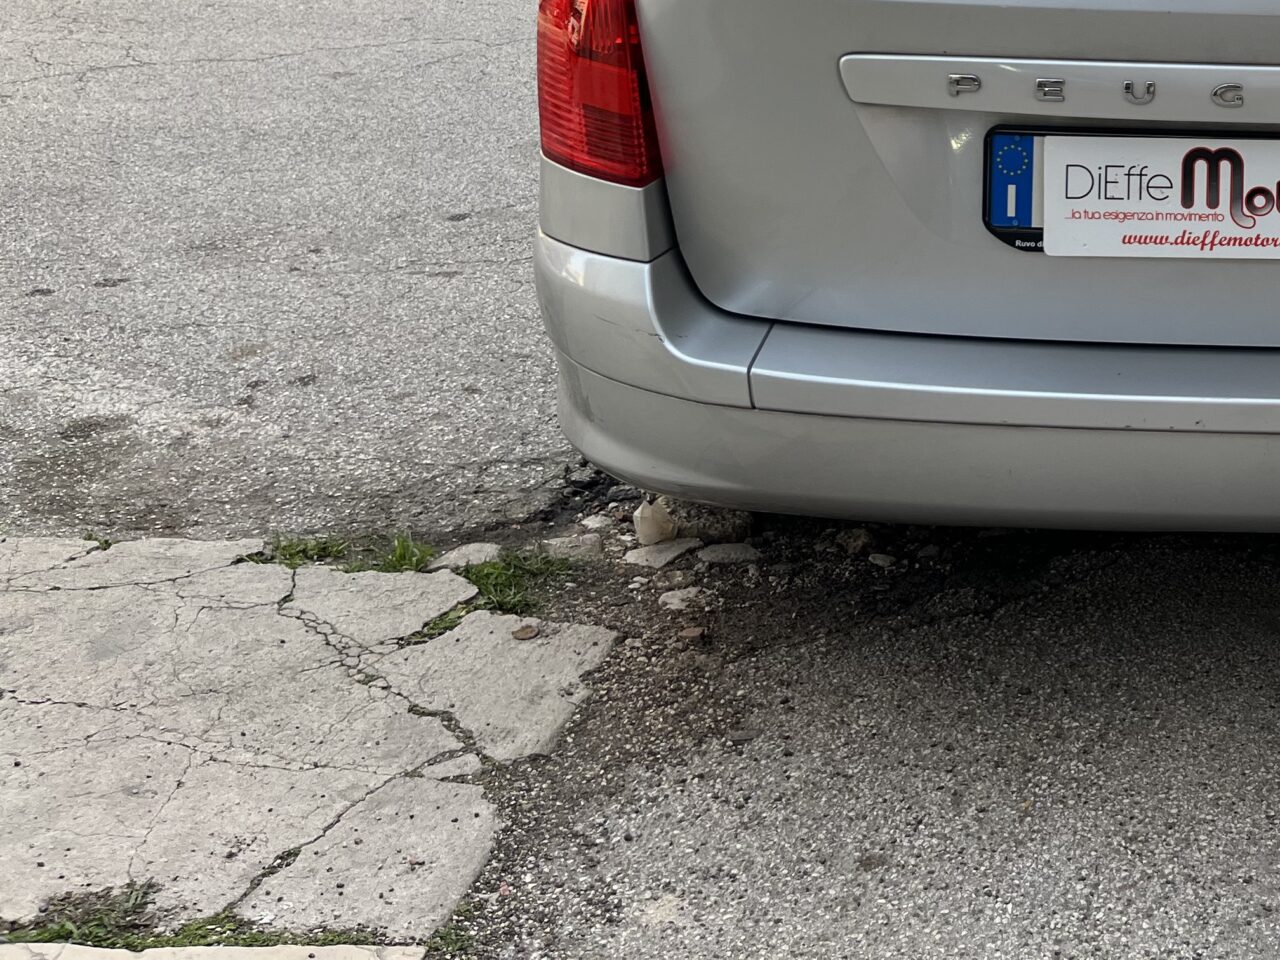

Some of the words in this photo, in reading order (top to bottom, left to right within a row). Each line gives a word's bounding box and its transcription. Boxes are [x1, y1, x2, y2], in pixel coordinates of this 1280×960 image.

[1065, 164, 1173, 201] DiEffe
[1007, 184, 1016, 217] I
[1083, 209, 1101, 220] tua
[1103, 211, 1154, 223] esigenza
[1155, 211, 1165, 221] in
[1165, 211, 1225, 222] movimento
